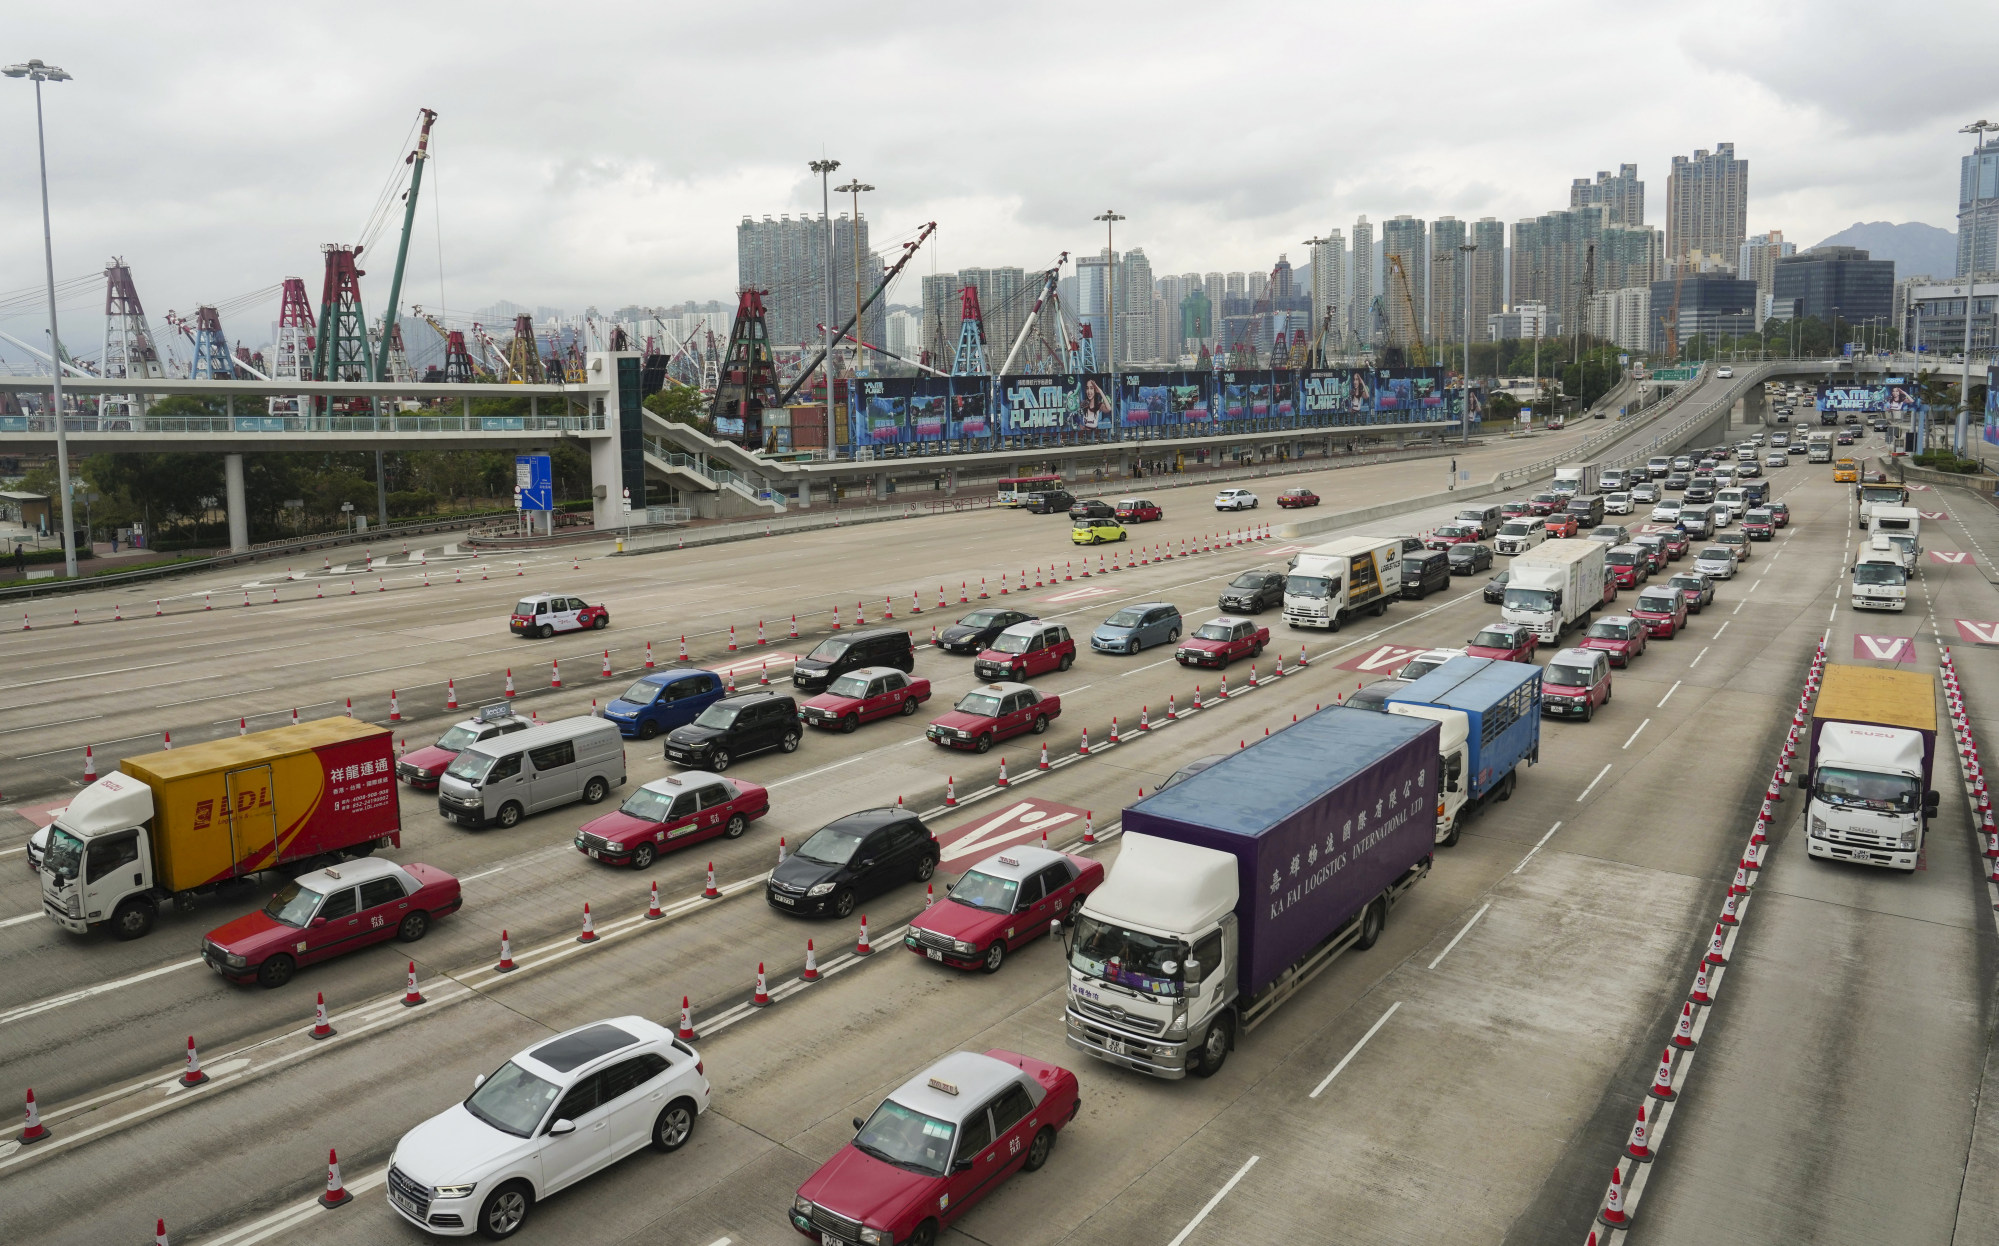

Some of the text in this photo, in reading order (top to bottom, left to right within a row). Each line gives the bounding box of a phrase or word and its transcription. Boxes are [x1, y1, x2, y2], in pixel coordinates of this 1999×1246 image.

[1304, 378, 1339, 396] YAMI
[1825, 389, 1869, 400] YAMI
[1007, 386, 1063, 409] YAMI
[1305, 395, 1341, 410] PLANET
[1827, 399, 1871, 409] PLANET
[1011, 408, 1066, 429] PLANET
[1850, 729, 1895, 739] ISUZU
[330, 758, 389, 784] 祥龍運通
[100, 780, 124, 792] ISUZU
[220, 787, 272, 816] LDL
[1849, 826, 1878, 834] ISUZU
[1270, 797, 1423, 920] KA FAI LOGISTICS INTERNATIONAL LTD
[372, 919, 384, 928] TAXI
